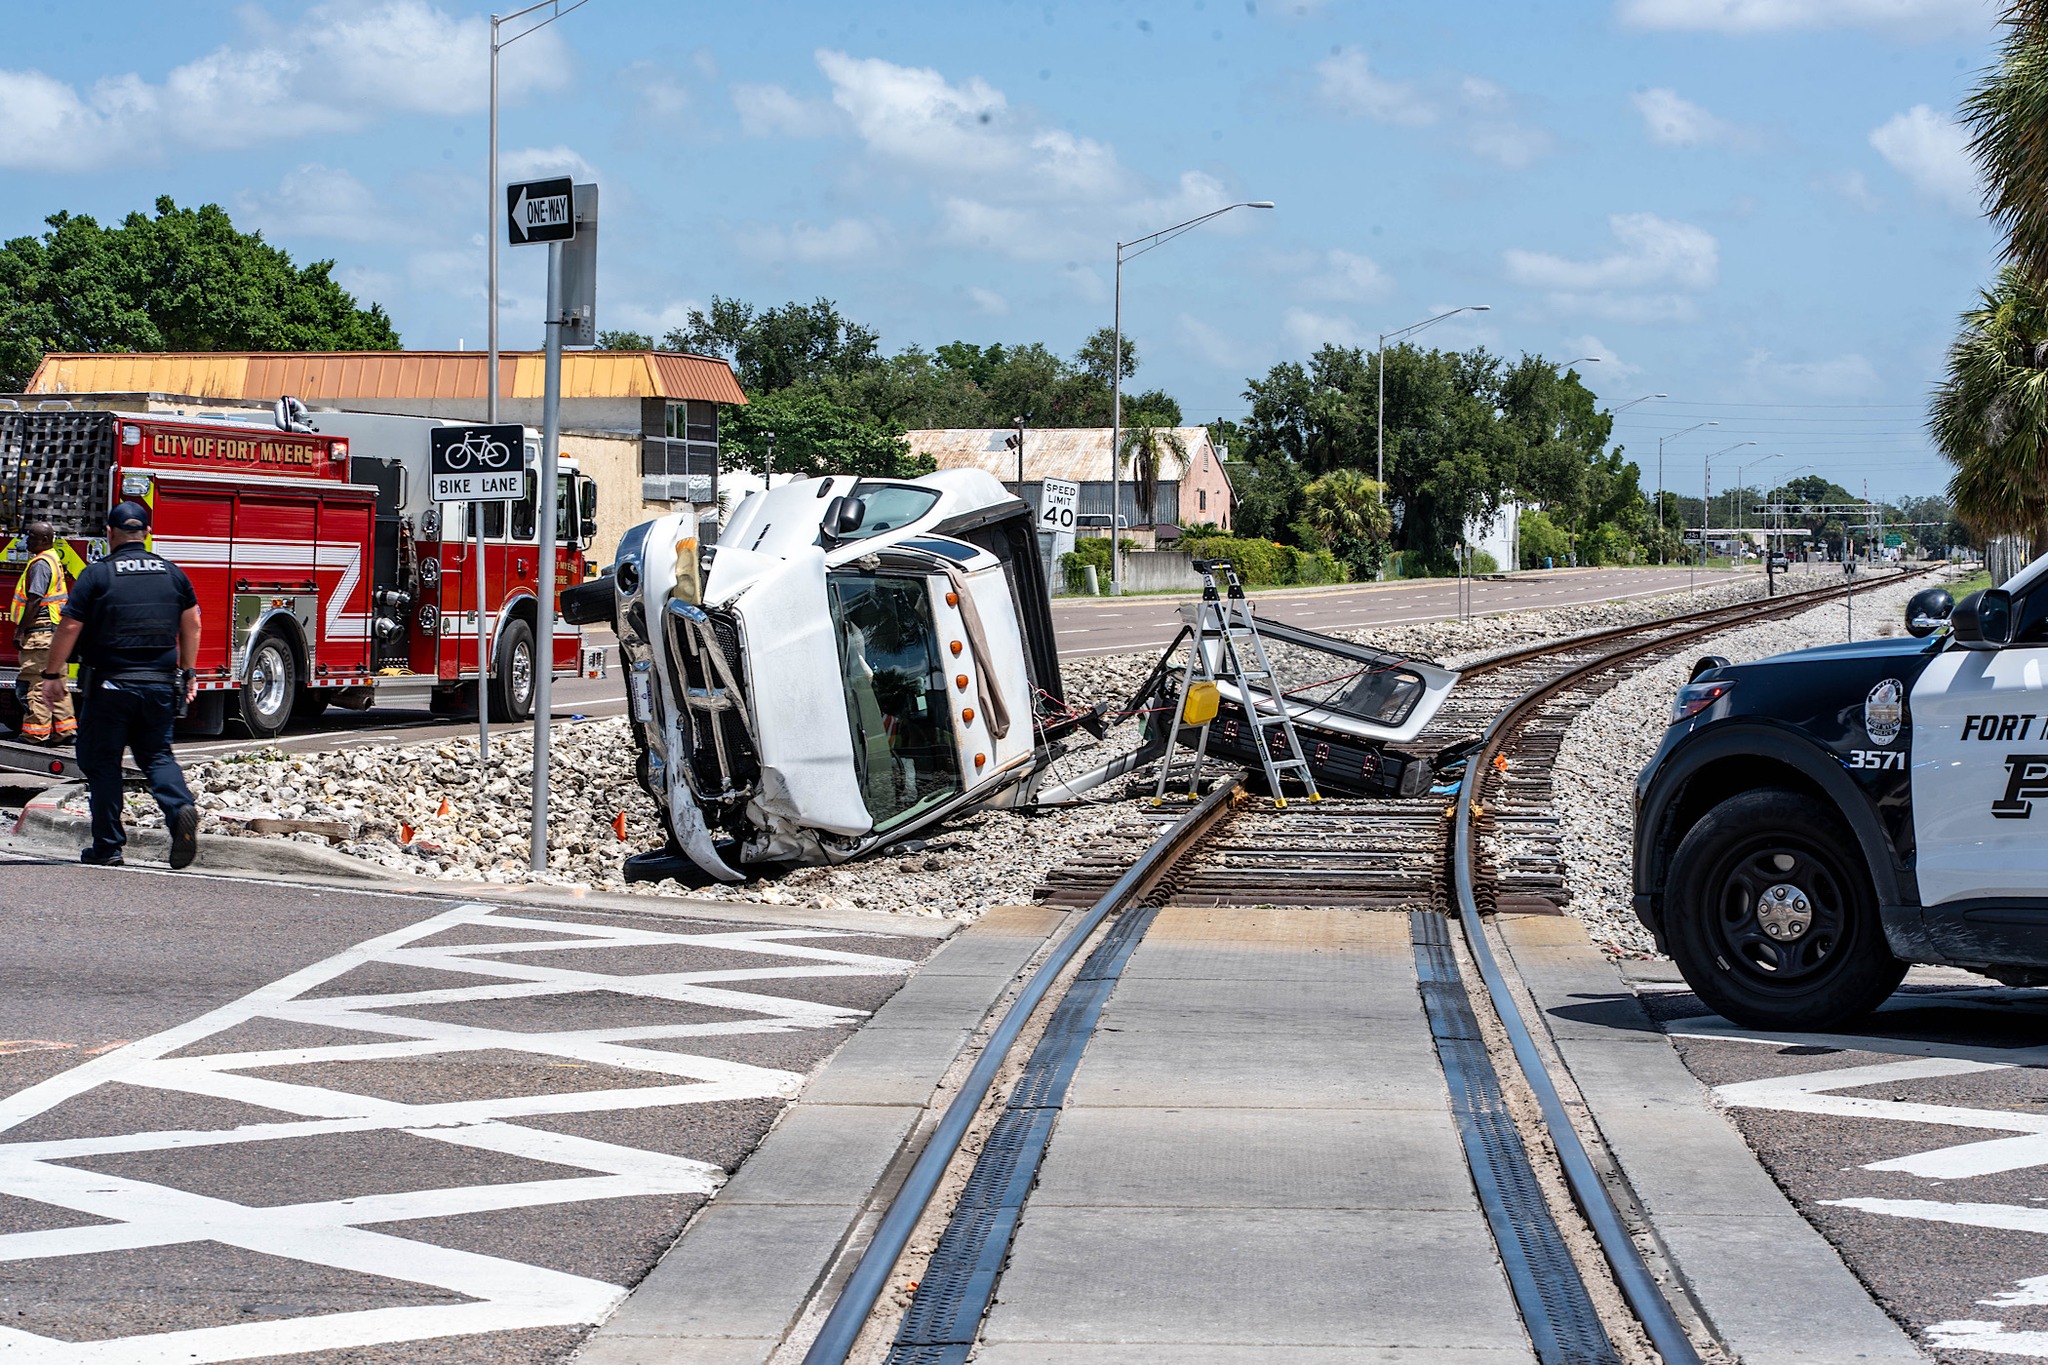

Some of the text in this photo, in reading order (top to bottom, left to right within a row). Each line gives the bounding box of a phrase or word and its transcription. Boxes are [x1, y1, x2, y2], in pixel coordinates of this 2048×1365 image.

[527, 197, 567, 224] ONE WAY
[153, 434, 313, 466] CITY OF FORT MYERS
[440, 477, 517, 494] BIKE LANE
[1045, 483, 1076, 496] SPEED
[1048, 495, 1072, 506] LIMIT
[1043, 506, 1074, 528] 40
[115, 559, 166, 573] POLICE
[1842, 563, 1856, 575] W
[1961, 714, 2037, 741] FORT
[1849, 750, 1905, 770] 3571
